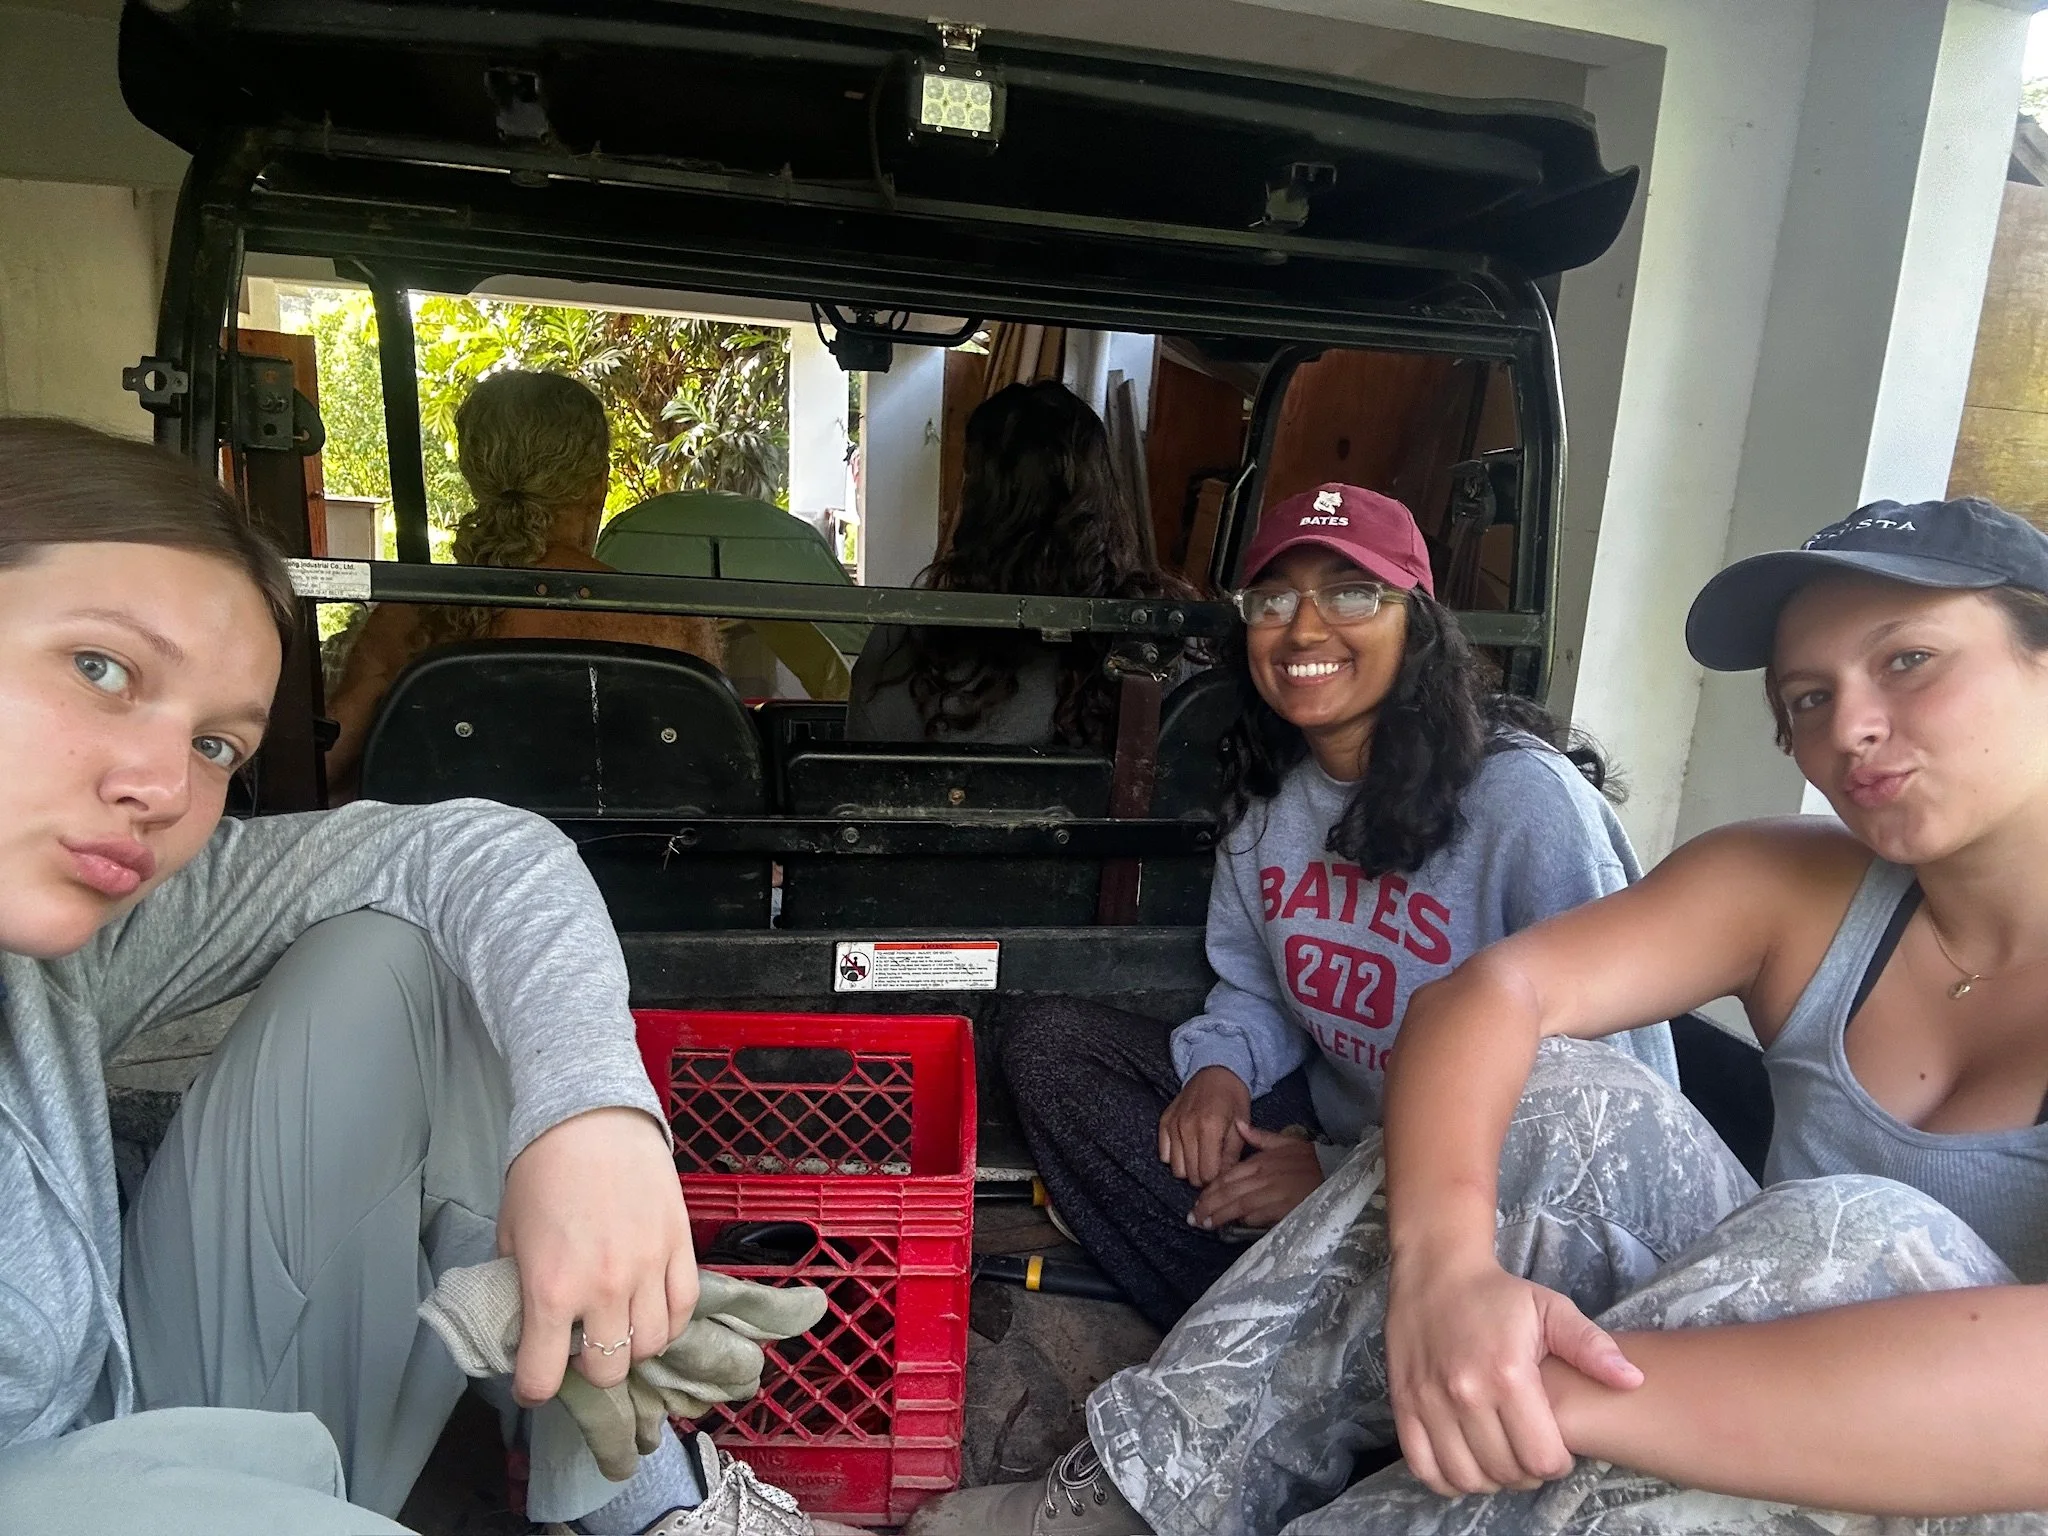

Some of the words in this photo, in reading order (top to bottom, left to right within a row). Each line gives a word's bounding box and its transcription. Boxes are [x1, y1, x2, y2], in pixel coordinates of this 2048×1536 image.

[1299, 516, 1348, 526] BATES
[1259, 861, 1452, 965] BATES
[1297, 944, 1382, 1020] 272
